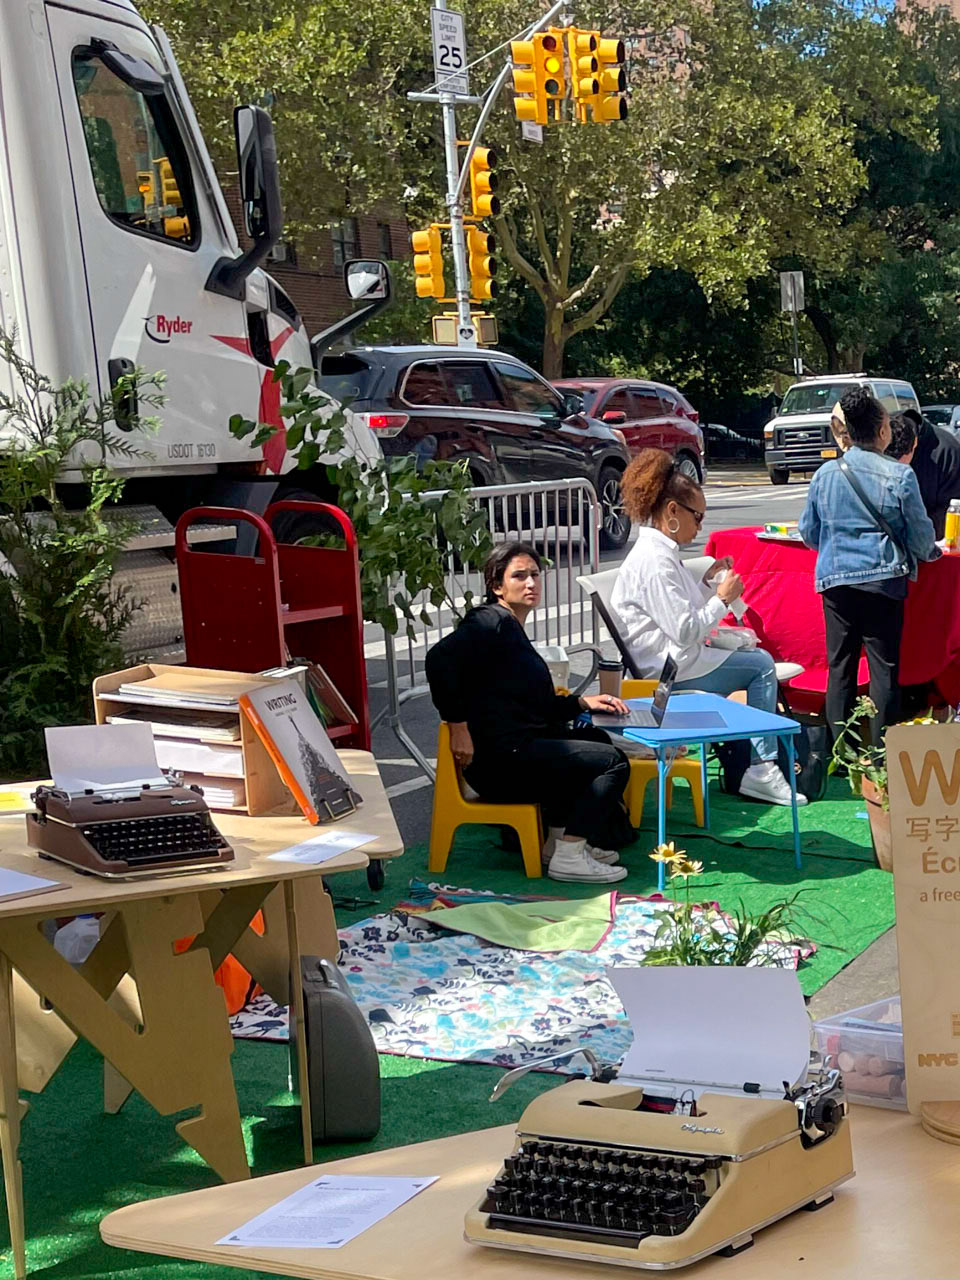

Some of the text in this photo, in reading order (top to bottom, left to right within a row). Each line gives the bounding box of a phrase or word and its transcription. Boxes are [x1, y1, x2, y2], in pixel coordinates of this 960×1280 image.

[440, 14, 454, 23] CITY
[438, 23, 457, 34] SPEED
[441, 33, 456, 42] LIMIT
[438, 44, 463, 69] 25
[156, 314, 193, 338] Ryder
[167, 444, 194, 459] USDOT
[264, 693, 298, 712] WRITING
[906, 815, 960, 843] 写字
[919, 891, 929, 903] a
[918, 1052, 959, 1068] NYC
